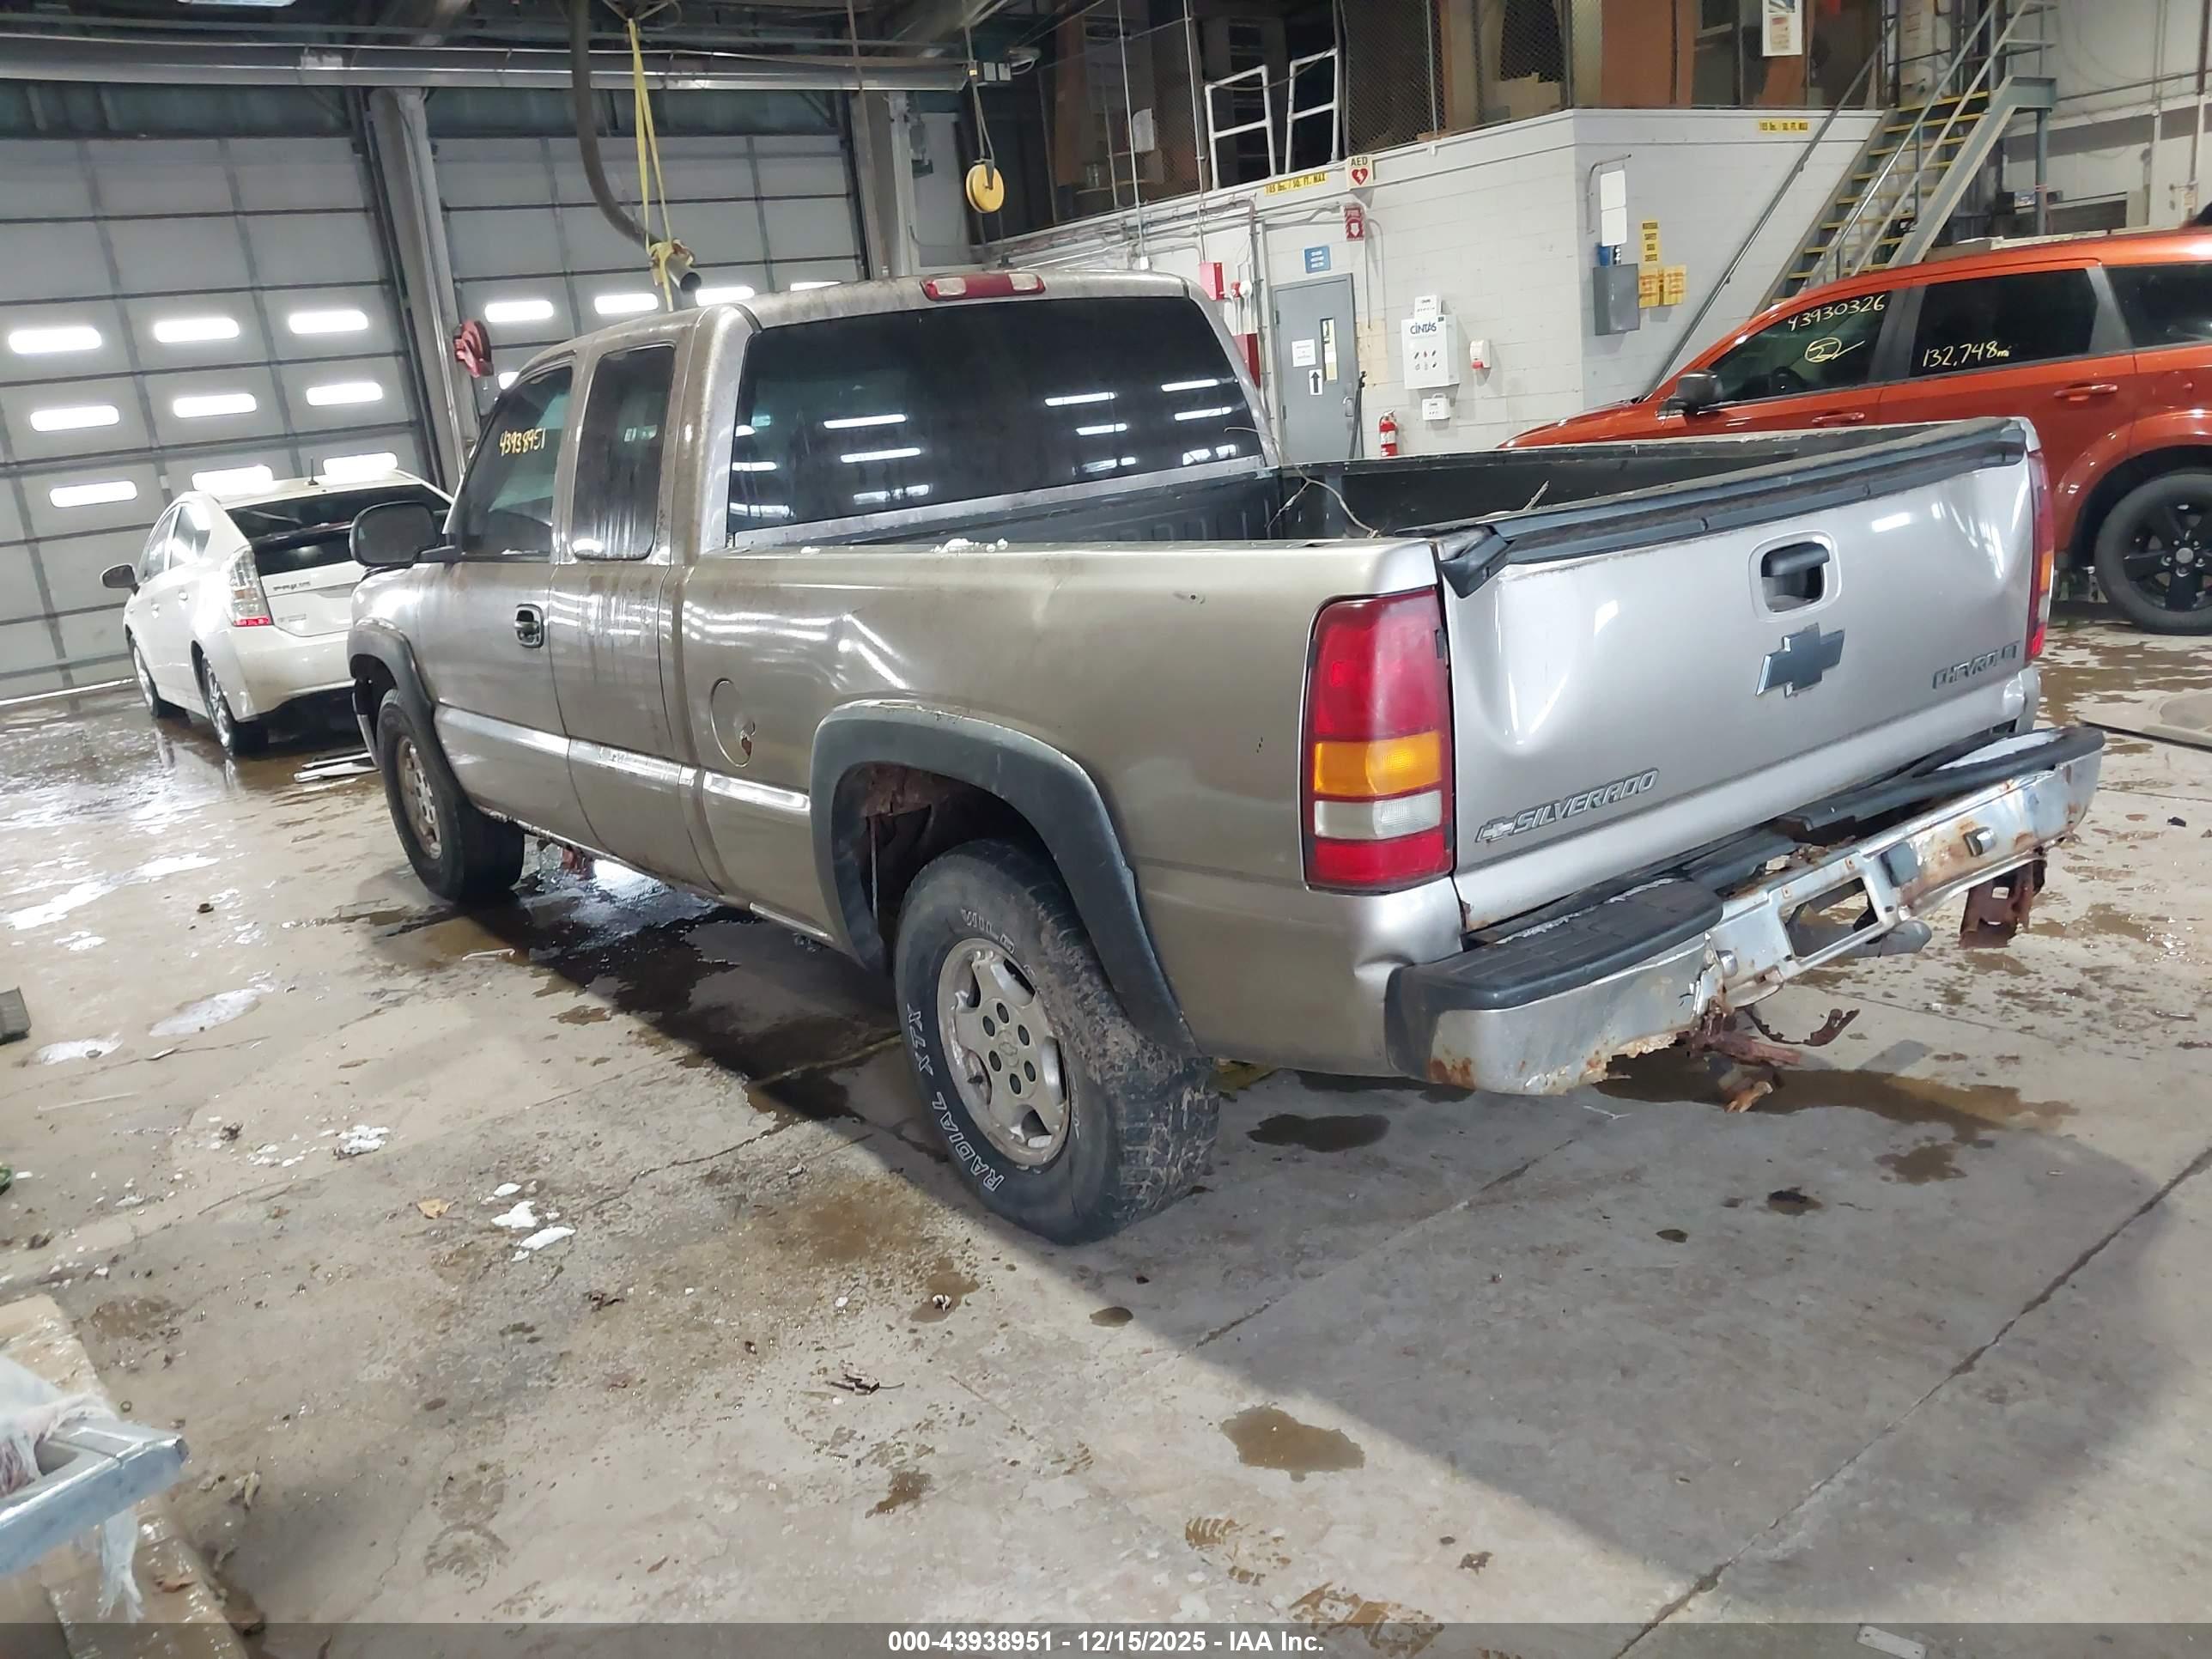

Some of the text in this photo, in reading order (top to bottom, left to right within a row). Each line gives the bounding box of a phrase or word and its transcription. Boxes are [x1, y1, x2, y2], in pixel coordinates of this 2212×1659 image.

[1351, 156, 1368, 167] AED
[1788, 295, 1886, 331] 43930326
[499, 428, 546, 457] 43938951
[1510, 767, 1660, 835] SILVERADO
[906, 1002, 1005, 1192] RADIAL XTX
